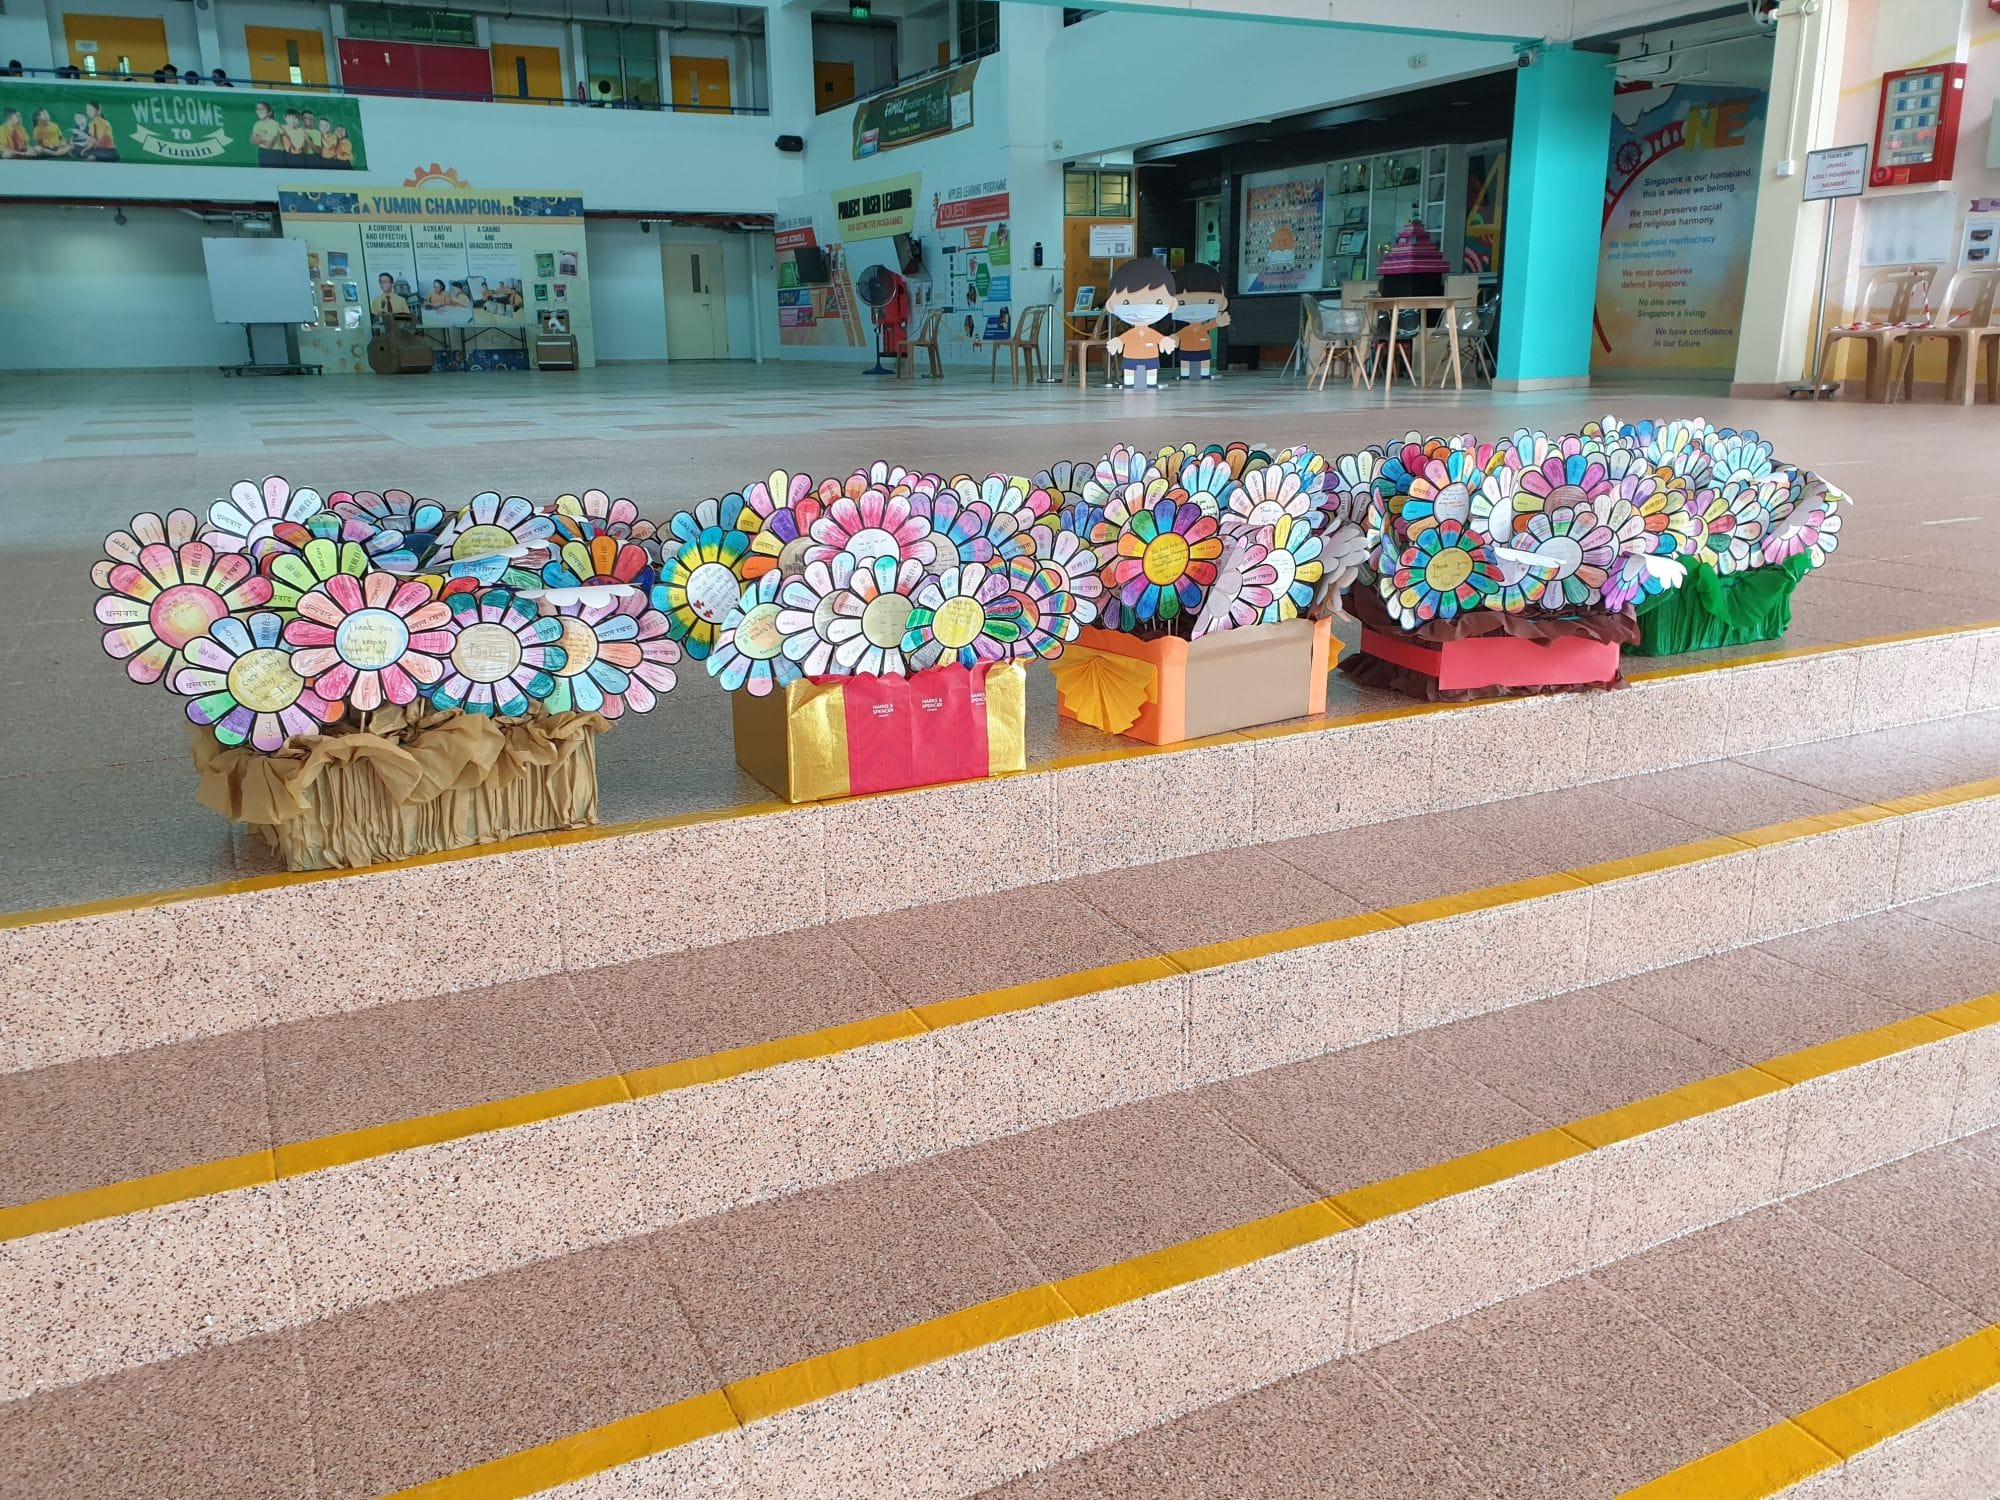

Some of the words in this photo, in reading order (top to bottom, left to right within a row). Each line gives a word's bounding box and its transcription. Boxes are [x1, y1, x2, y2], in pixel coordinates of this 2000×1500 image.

[131, 96, 225, 127] WELCOME
[171, 128, 192, 140] TO
[157, 142, 212, 157] Yumin
[1828, 169, 1860, 178] HOUSEHOLD
[1644, 176, 1682, 187] Singapore
[947, 186, 962, 199] APPLIED
[963, 183, 982, 197] LEARNING
[982, 178, 1007, 194] PROGRAMME
[1643, 189, 1656, 198] this
[1659, 189, 1665, 197] is
[1667, 186, 1691, 195] where
[362, 203, 371, 214] A
[371, 196, 421, 214] YUMIN
[425, 198, 500, 215] CHAMPION
[502, 205, 513, 216] IS
[838, 198, 861, 220] PROJECT
[862, 195, 882, 215] BASED
[882, 188, 912, 212] LEARNING
[1629, 209, 1641, 217] We
[1643, 207, 1662, 216] must
[1663, 206, 1698, 217] preserve
[1700, 202, 1722, 212] racial
[1628, 221, 1642, 229] and
[1644, 217, 1676, 229] religious
[366, 241, 410, 249] COMMUNICATOR
[1609, 240, 1621, 248] We
[1622, 239, 1639, 247] must
[1641, 237, 1667, 248] uphold
[1669, 235, 1717, 245] meritocracy
[1622, 269, 1634, 277] We
[1635, 268, 1654, 276] must
[1655, 267, 1693, 276] ourselves
[1621, 280, 1645, 289] defend
[1638, 298, 1649, 306] No
[1638, 309, 1675, 319] Singapore
[1655, 328, 1666, 336] We
[1668, 328, 1687, 336] have
[1689, 327, 1734, 336] confidence
[349, 619, 373, 632] Thank
